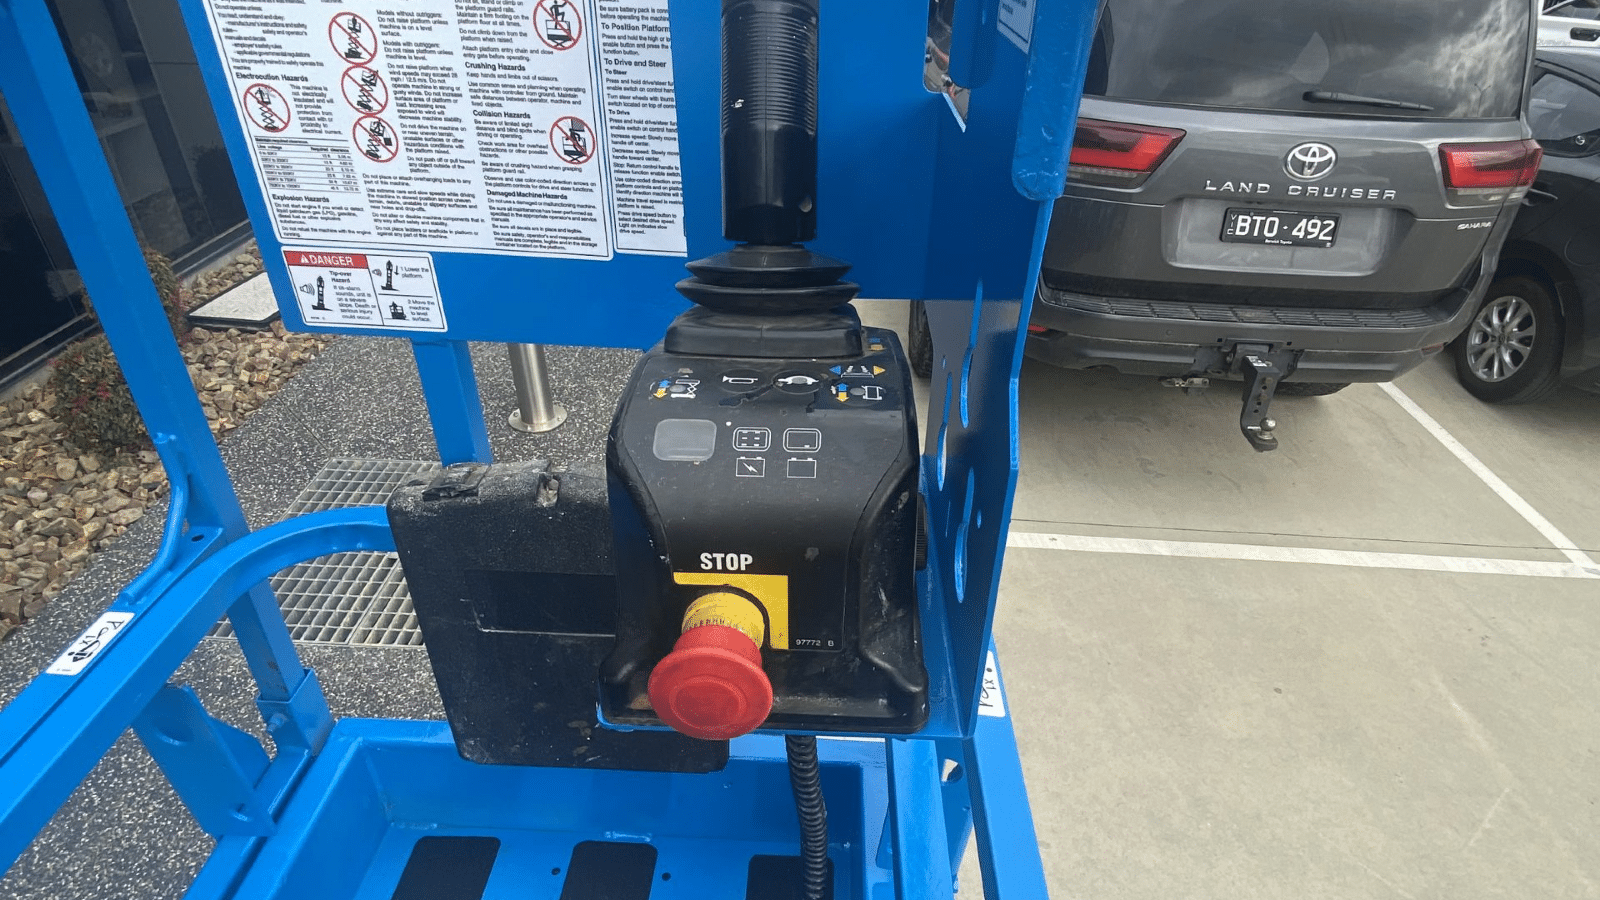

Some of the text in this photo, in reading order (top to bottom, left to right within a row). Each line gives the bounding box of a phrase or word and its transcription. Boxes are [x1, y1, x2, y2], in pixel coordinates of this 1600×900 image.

[612, 22, 640, 31] Position
[465, 61, 526, 71] Crushing Hazards
[615, 58, 632, 66] Drive
[634, 59, 647, 67] and
[649, 59, 666, 67] Steer
[473, 108, 531, 119] Collision Hazards
[487, 188, 568, 200] Damaged Machine Hazards
[1205, 180, 1397, 200] LAND CRUISER
[1457, 221, 1492, 230] SAHARA
[309, 255, 354, 266] DANGER
[700, 553, 753, 570] STOP
[796, 639, 821, 647] 97772
